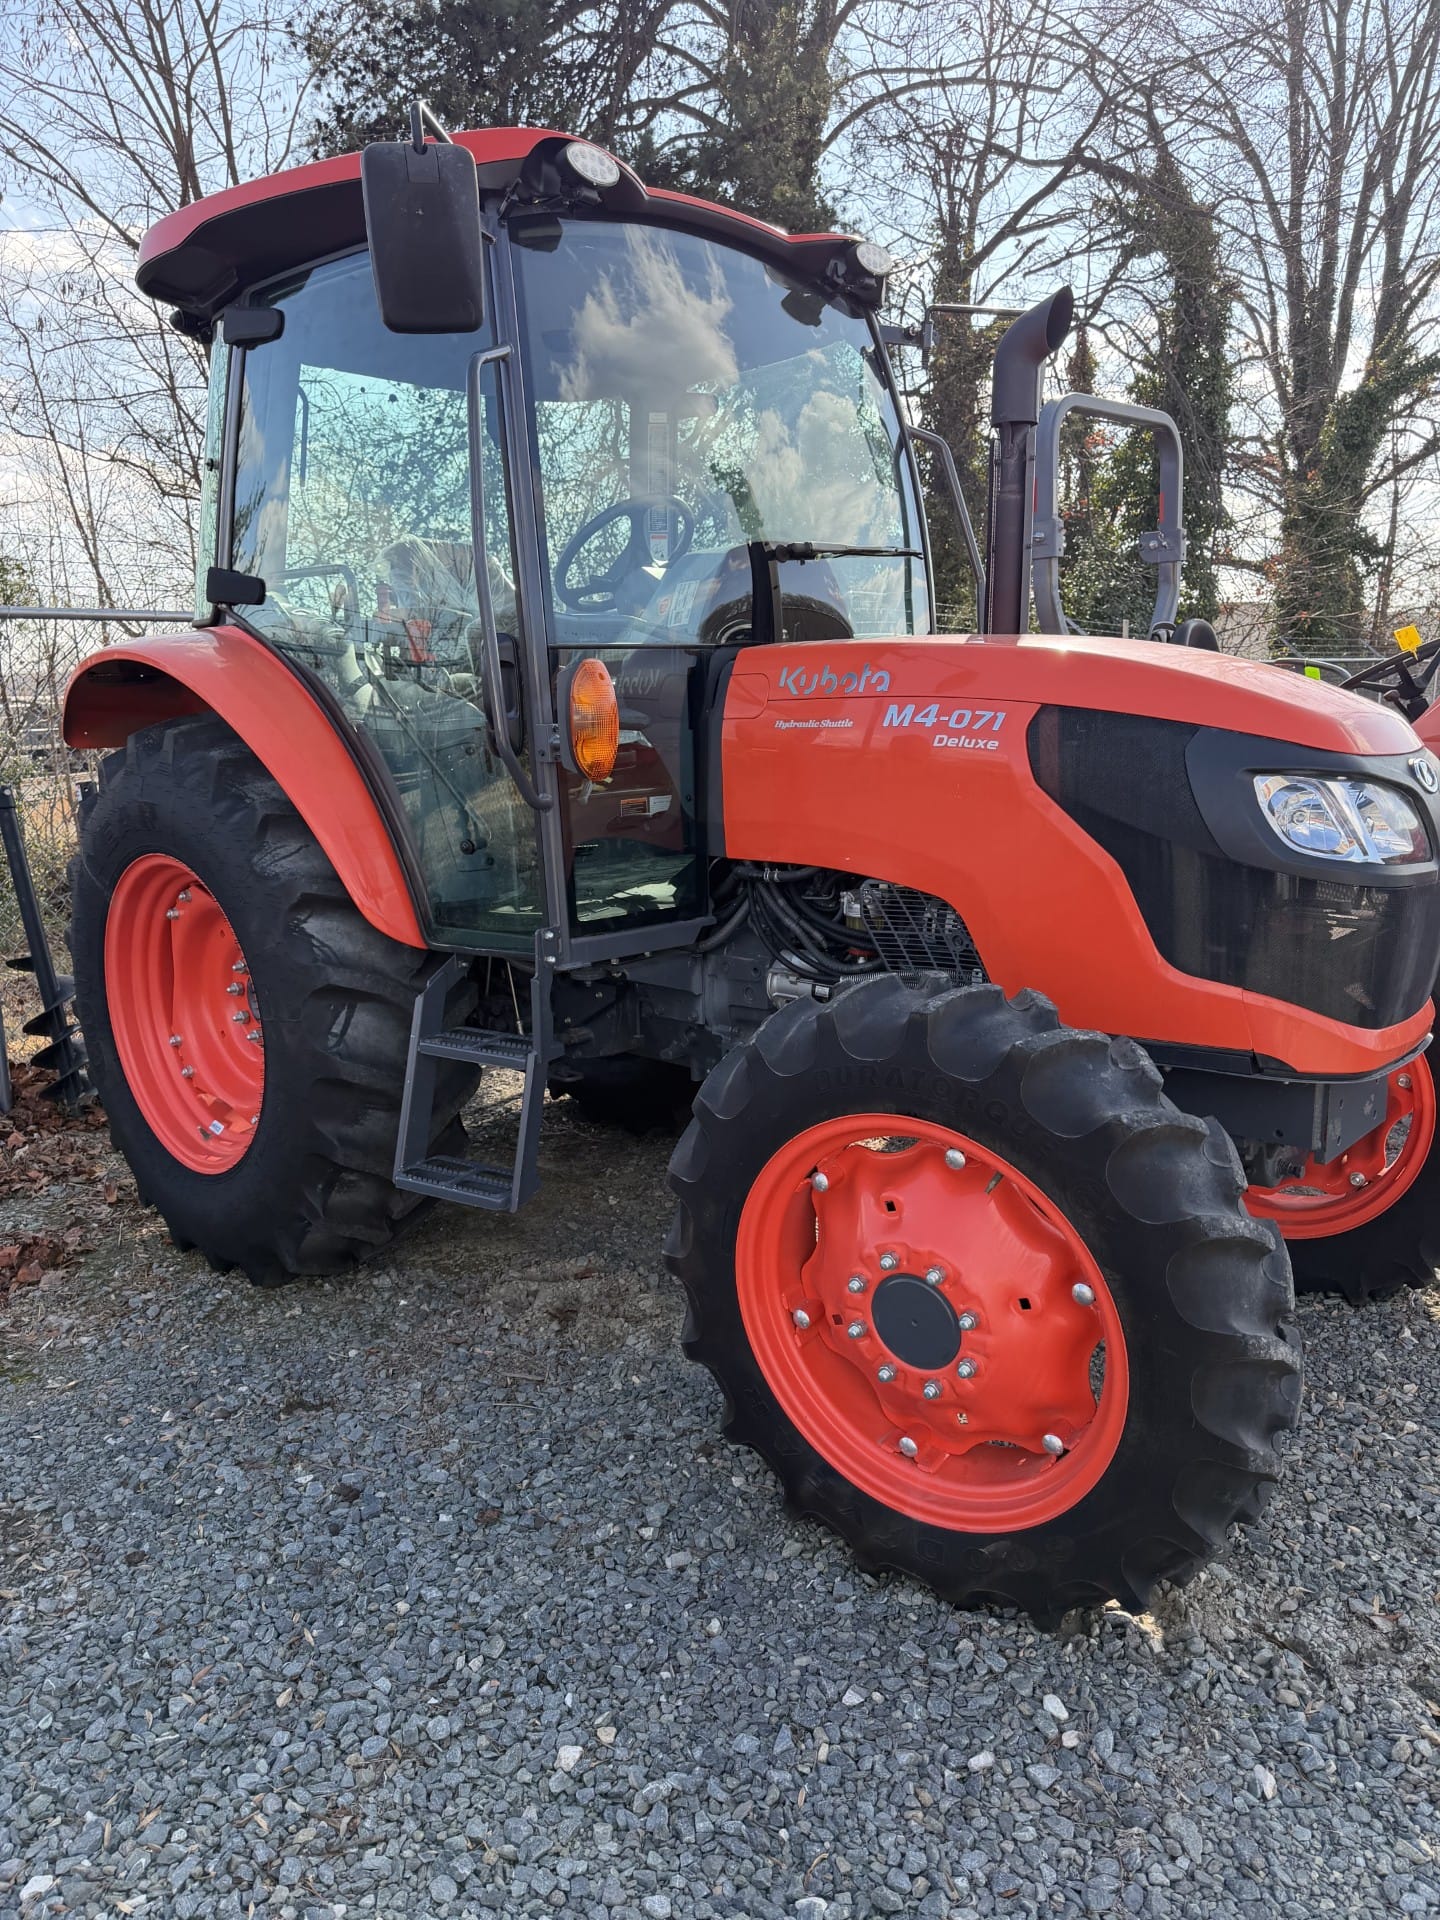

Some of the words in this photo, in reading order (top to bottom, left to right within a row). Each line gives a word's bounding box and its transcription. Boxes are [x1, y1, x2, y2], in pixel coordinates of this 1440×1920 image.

[778, 663, 890, 696] Kubota
[774, 719, 819, 729] Hydraulic
[820, 718, 854, 729] Shuttle
[882, 703, 1006, 731] M4-071
[933, 734, 999, 751] Deluxe
